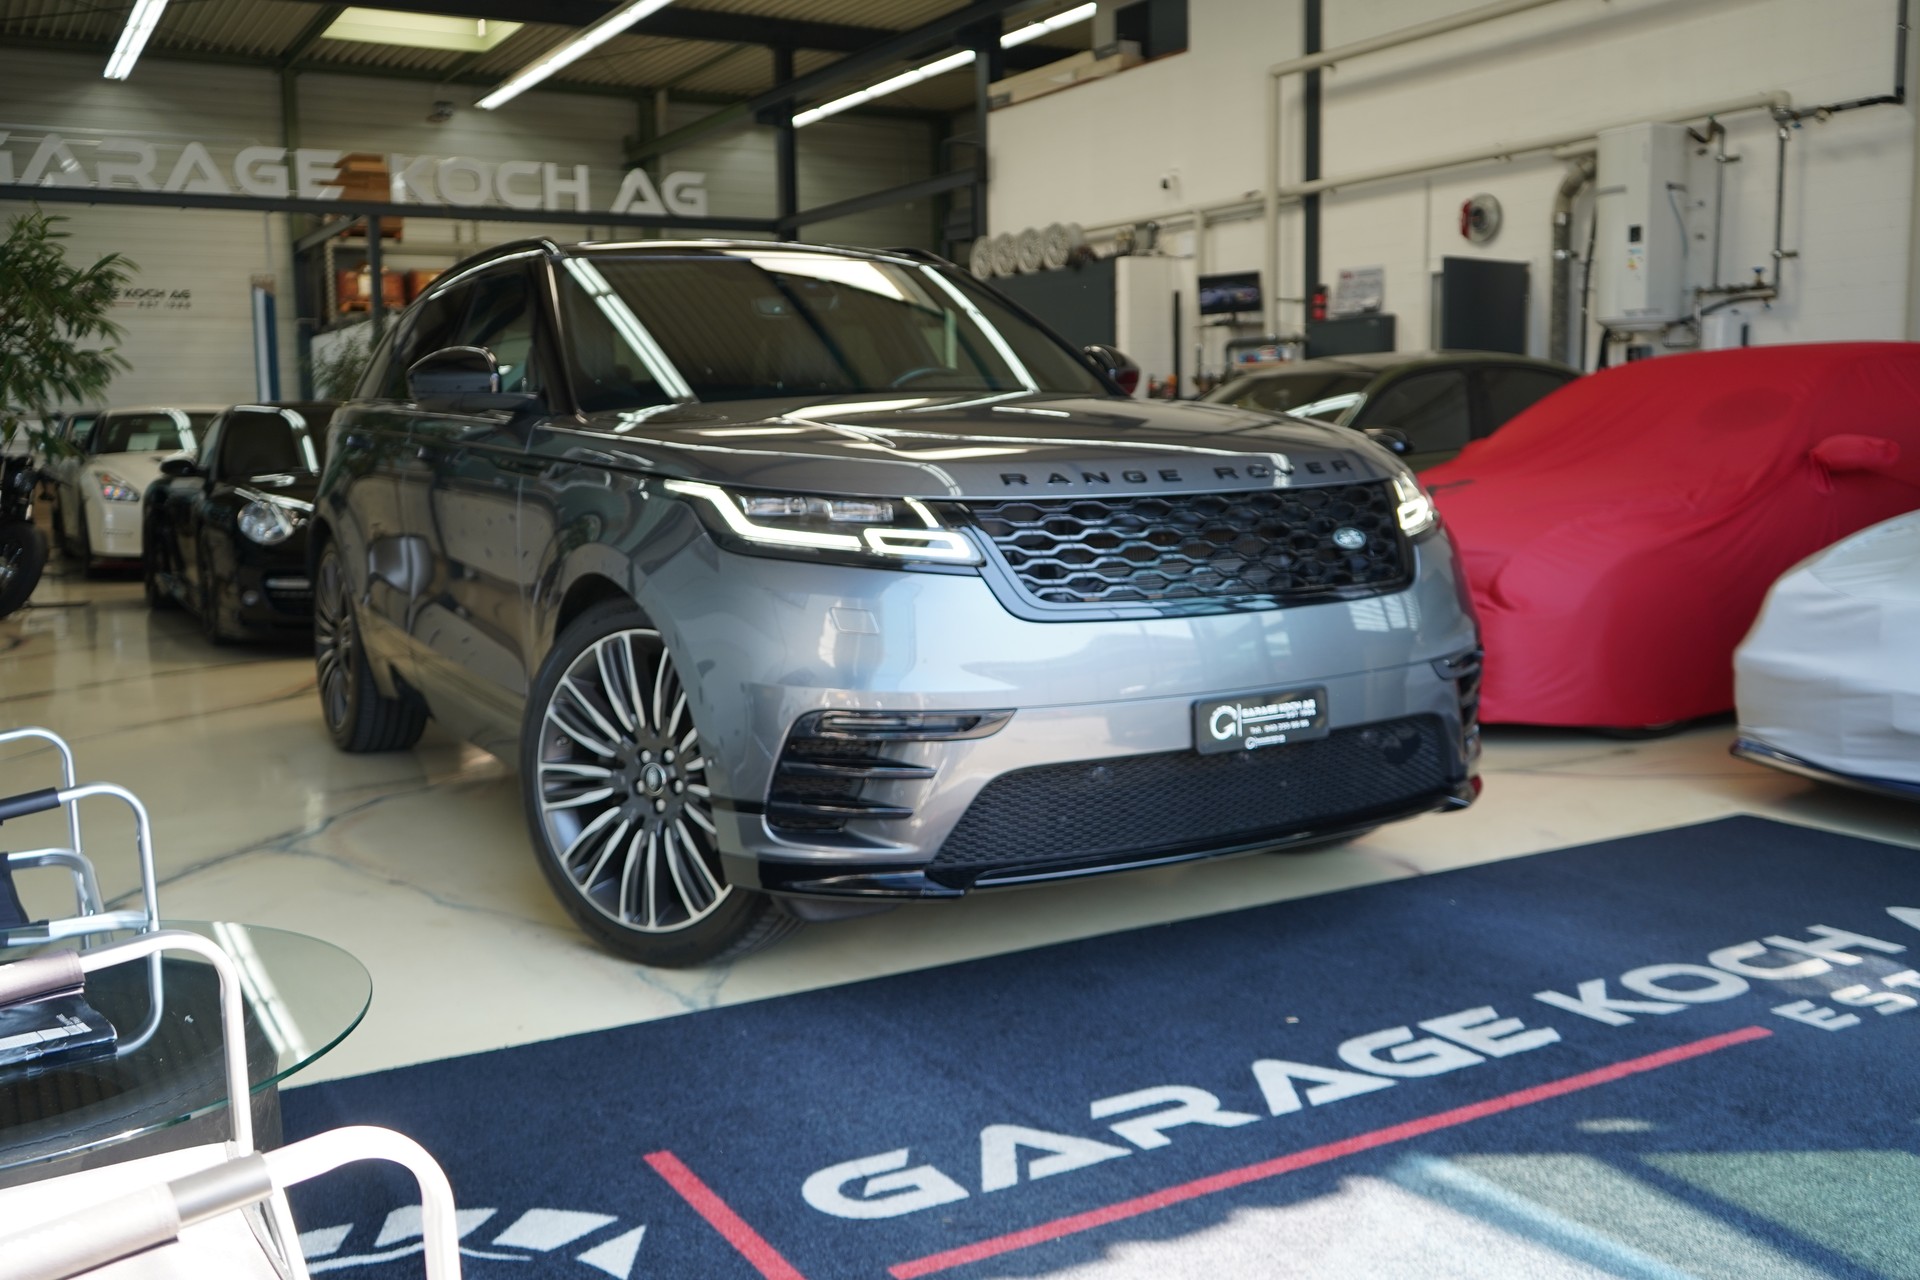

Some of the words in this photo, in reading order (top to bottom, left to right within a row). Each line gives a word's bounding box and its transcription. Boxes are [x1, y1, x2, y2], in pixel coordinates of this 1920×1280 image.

[391, 152, 591, 212] KOCH
[609, 167, 709, 217] AG
[169, 288, 192, 299] AG
[1000, 468, 1182, 486] RANGE
[802, 1005, 1562, 1222] GARAGE
[1533, 924, 1908, 1027] KOCH
